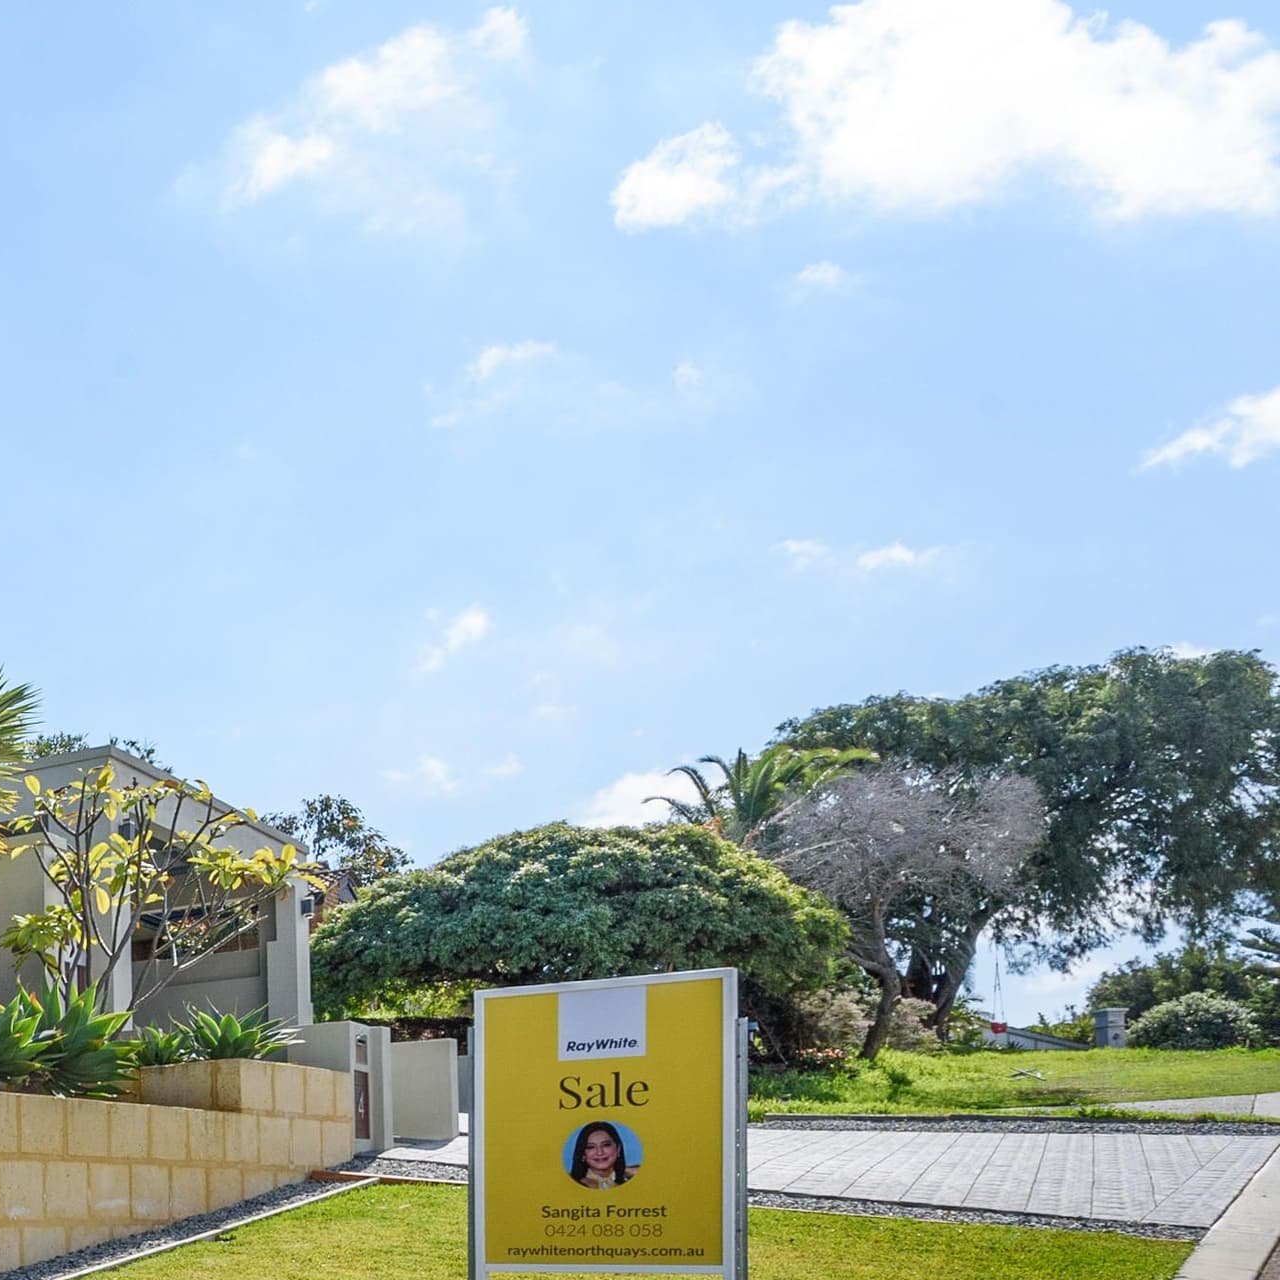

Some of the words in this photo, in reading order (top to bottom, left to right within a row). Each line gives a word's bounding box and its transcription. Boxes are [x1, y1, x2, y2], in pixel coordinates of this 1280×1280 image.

[558, 1071, 650, 1111] Sale
[358, 1090, 365, 1120] 4
[541, 1205, 601, 1221] Sangita
[606, 1204, 668, 1219] Forrest
[544, 1224, 587, 1238] 0424
[592, 1224, 625, 1238] 088
[629, 1223, 663, 1237] 058
[507, 1244, 705, 1259] raywhitenorthquays.com.au
